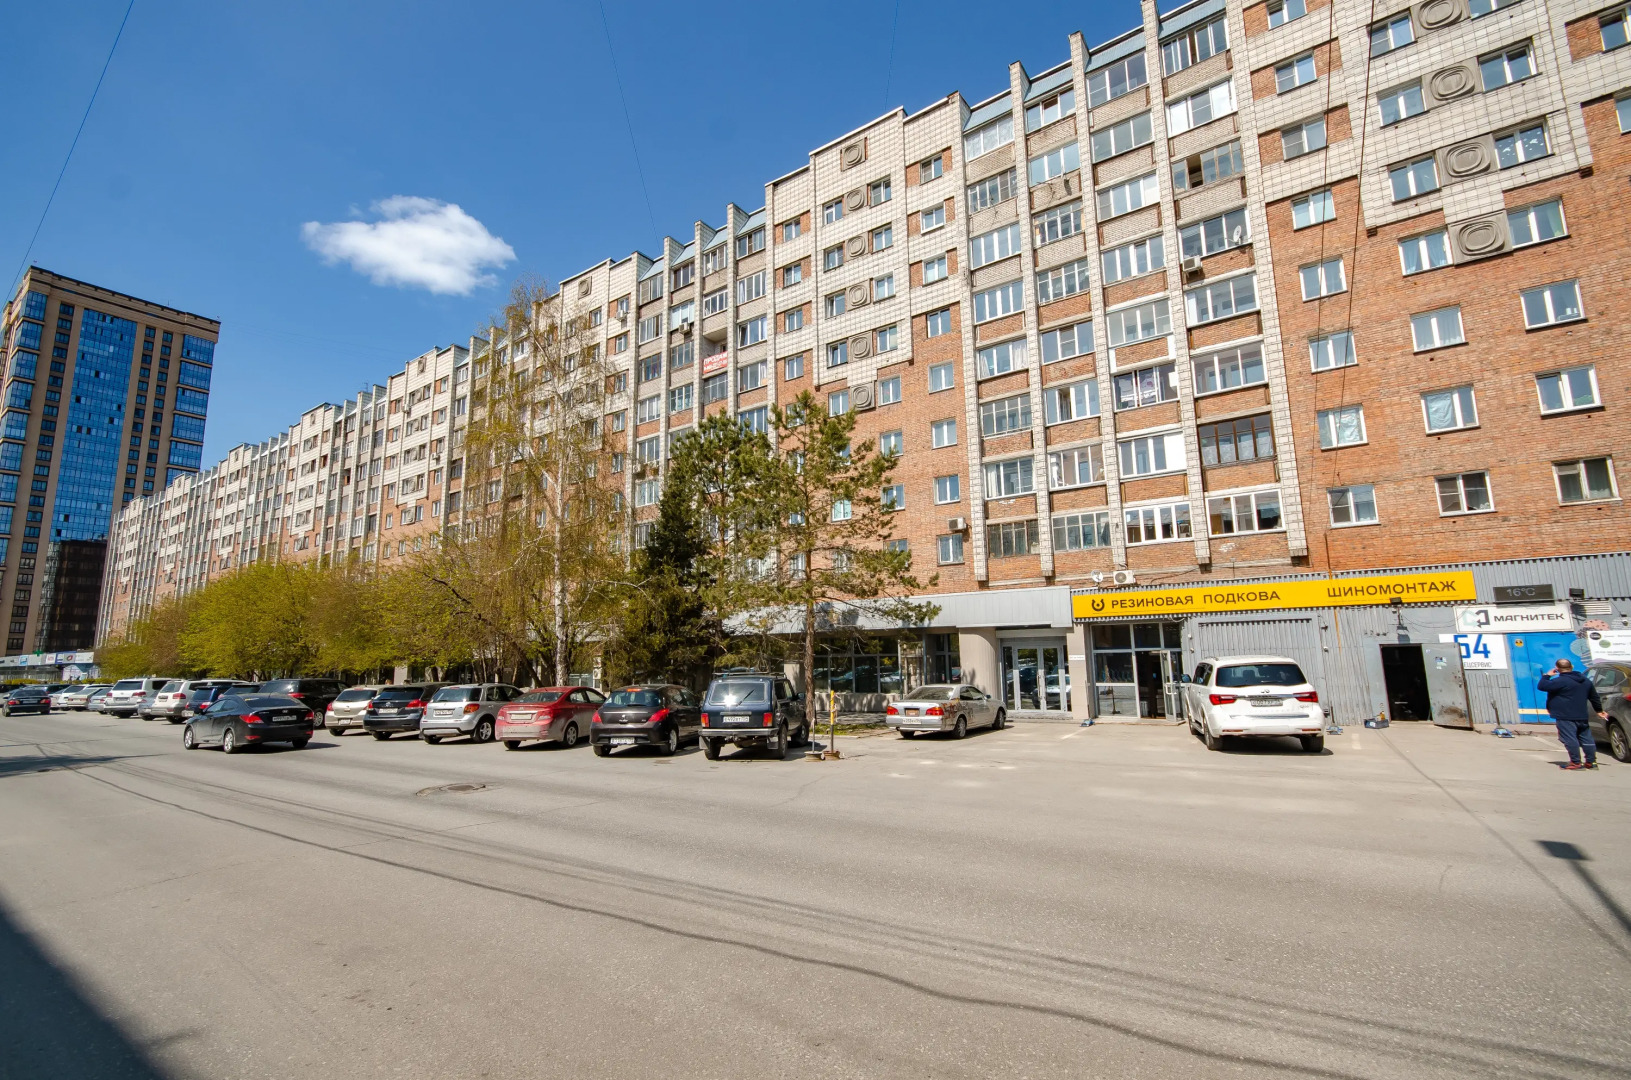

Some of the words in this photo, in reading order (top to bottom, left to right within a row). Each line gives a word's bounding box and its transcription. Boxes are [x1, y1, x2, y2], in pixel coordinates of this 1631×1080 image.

[1327, 580, 1457, 598] ШИНОМОНТАЖ
[1111, 595, 1194, 609] РЕЗИНОВАЯ
[1203, 590, 1281, 605] ПОДКОВА
[1493, 613, 1565, 622] МАГНИТЕК
[1453, 633, 1491, 659] 54
